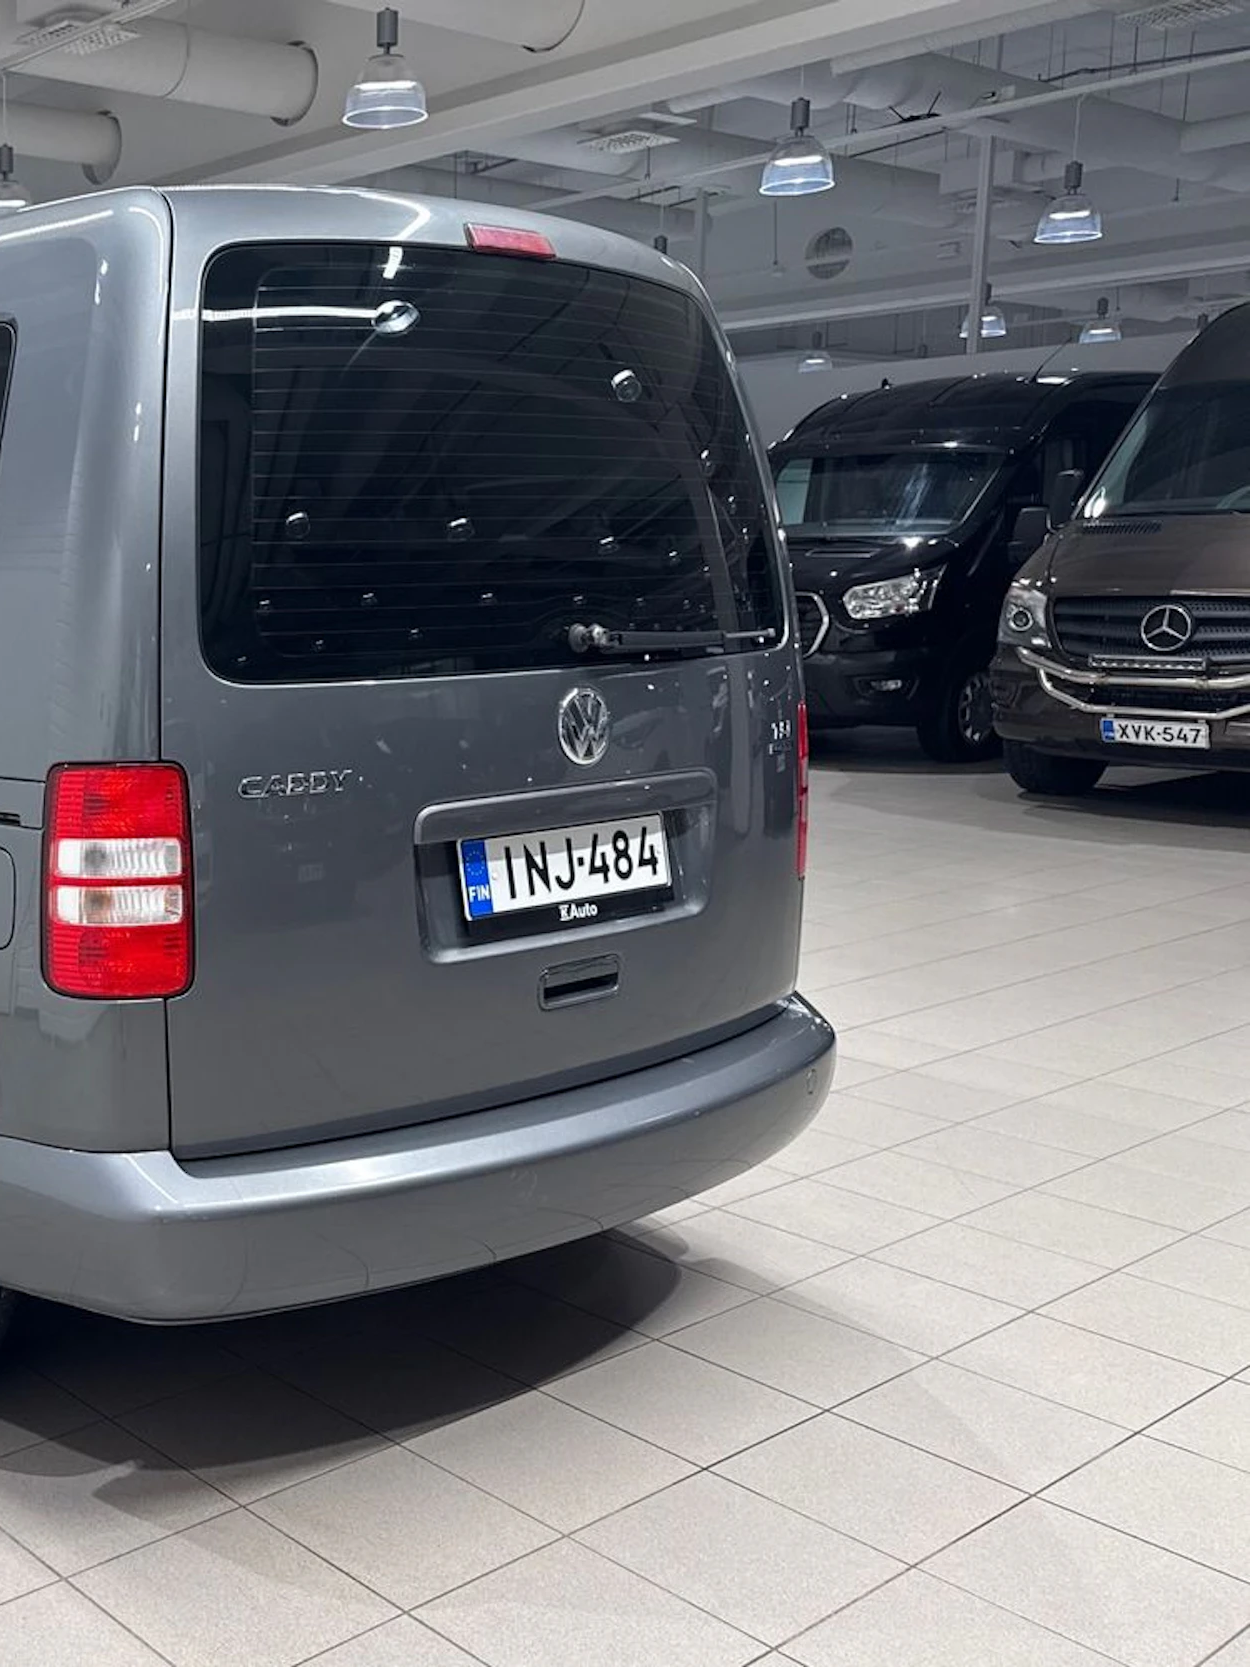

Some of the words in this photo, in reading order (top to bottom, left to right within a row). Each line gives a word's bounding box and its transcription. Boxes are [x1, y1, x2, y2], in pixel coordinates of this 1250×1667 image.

[1118, 723, 1202, 744] XVK-547
[237, 769, 353, 798] CADDY
[504, 826, 659, 899] INJ-484
[468, 883, 490, 902] FIN
